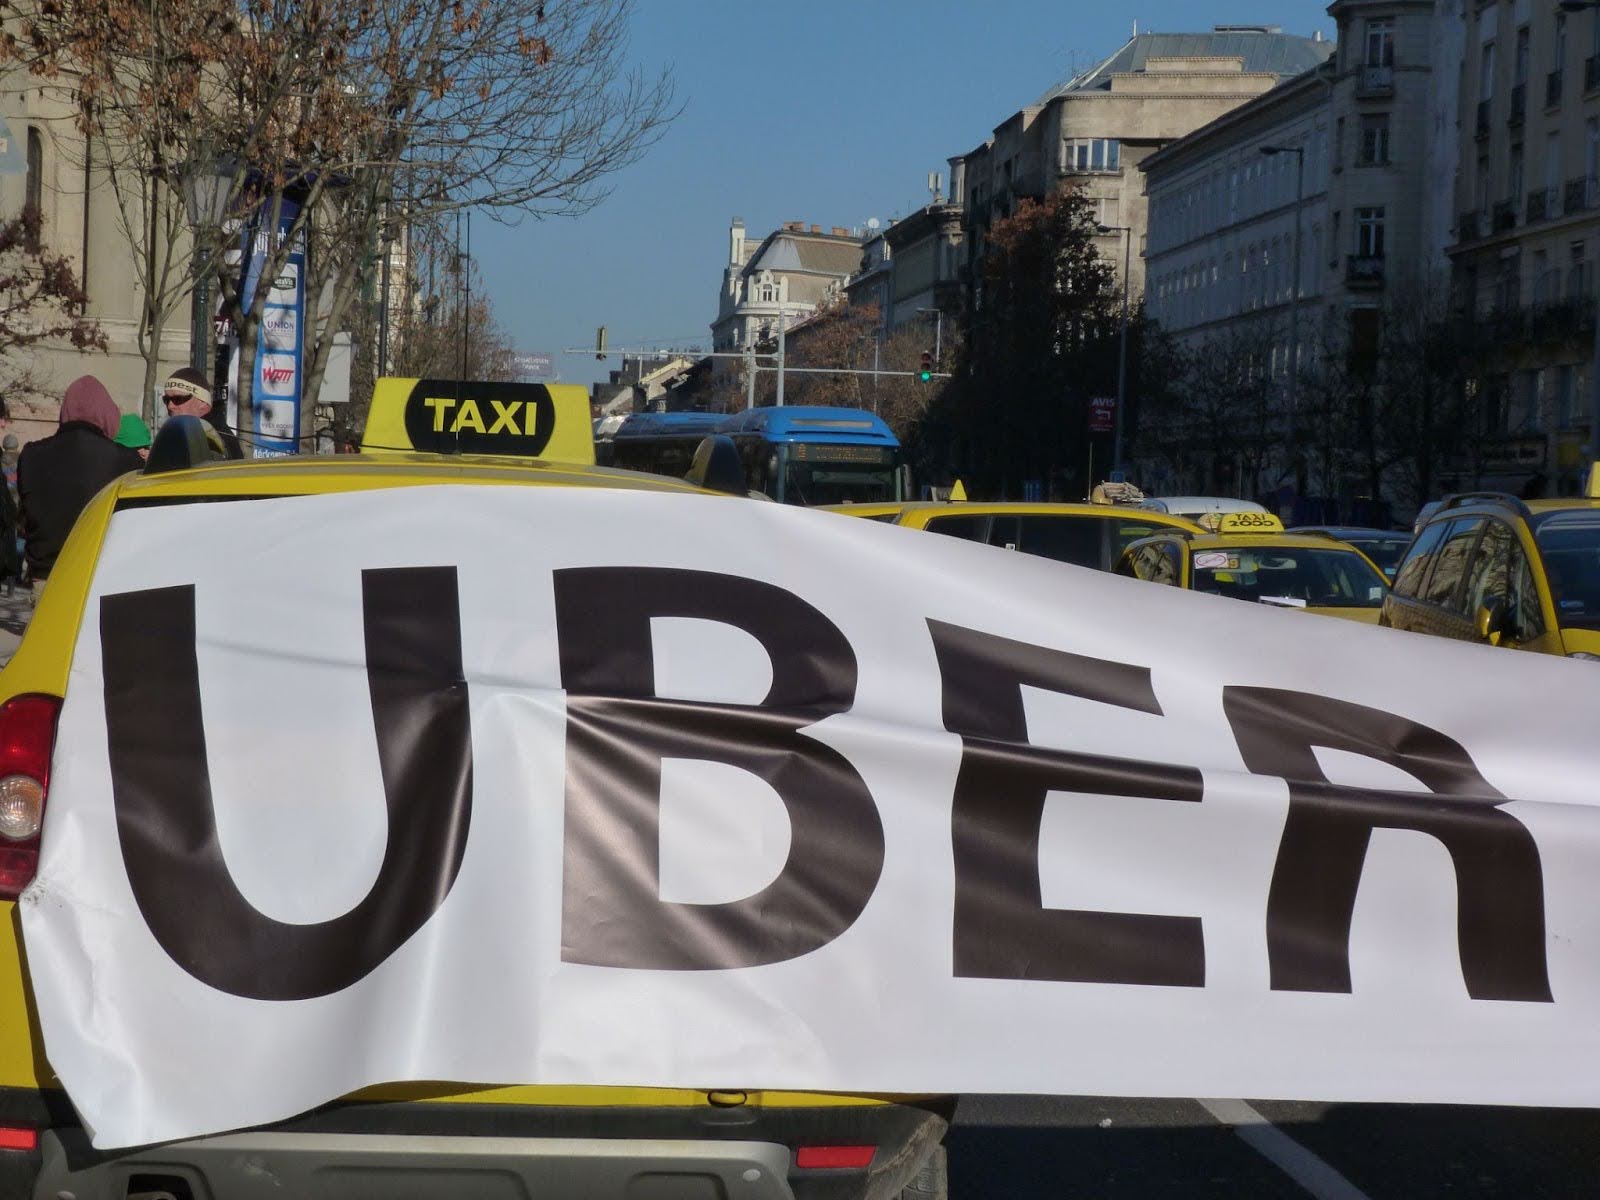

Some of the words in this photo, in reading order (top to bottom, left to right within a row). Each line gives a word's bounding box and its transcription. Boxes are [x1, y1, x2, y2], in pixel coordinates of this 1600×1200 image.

[267, 320, 295, 329] UNION
[262, 367, 294, 383] WATT
[1091, 397, 1115, 407] AVIS
[424, 397, 537, 437] TAXI
[1234, 513, 1266, 521] TAXI
[99, 565, 1554, 1002] UBER
